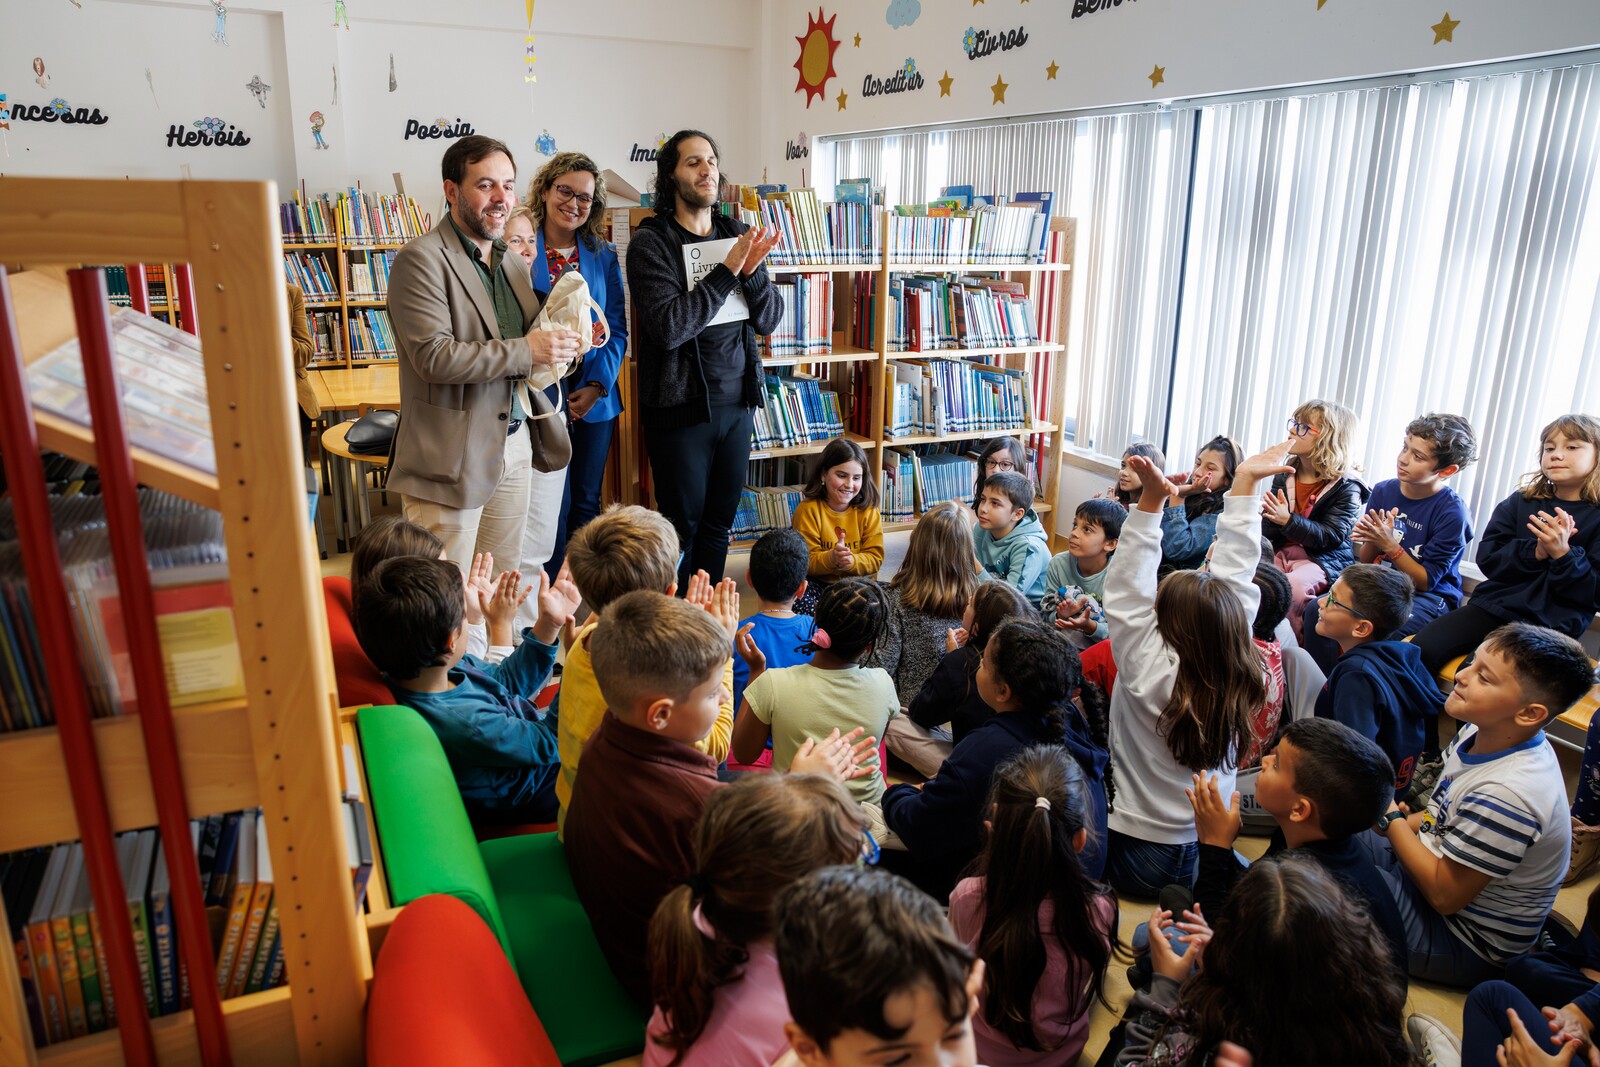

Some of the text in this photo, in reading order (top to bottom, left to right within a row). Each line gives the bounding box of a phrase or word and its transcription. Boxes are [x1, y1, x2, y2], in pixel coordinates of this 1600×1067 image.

[969, 26, 1029, 61] Livros
[862, 69, 924, 97] Acreditar
[404, 117, 475, 140] Poesia
[786, 140, 808, 160] Voar
[690, 247, 701, 259] O
